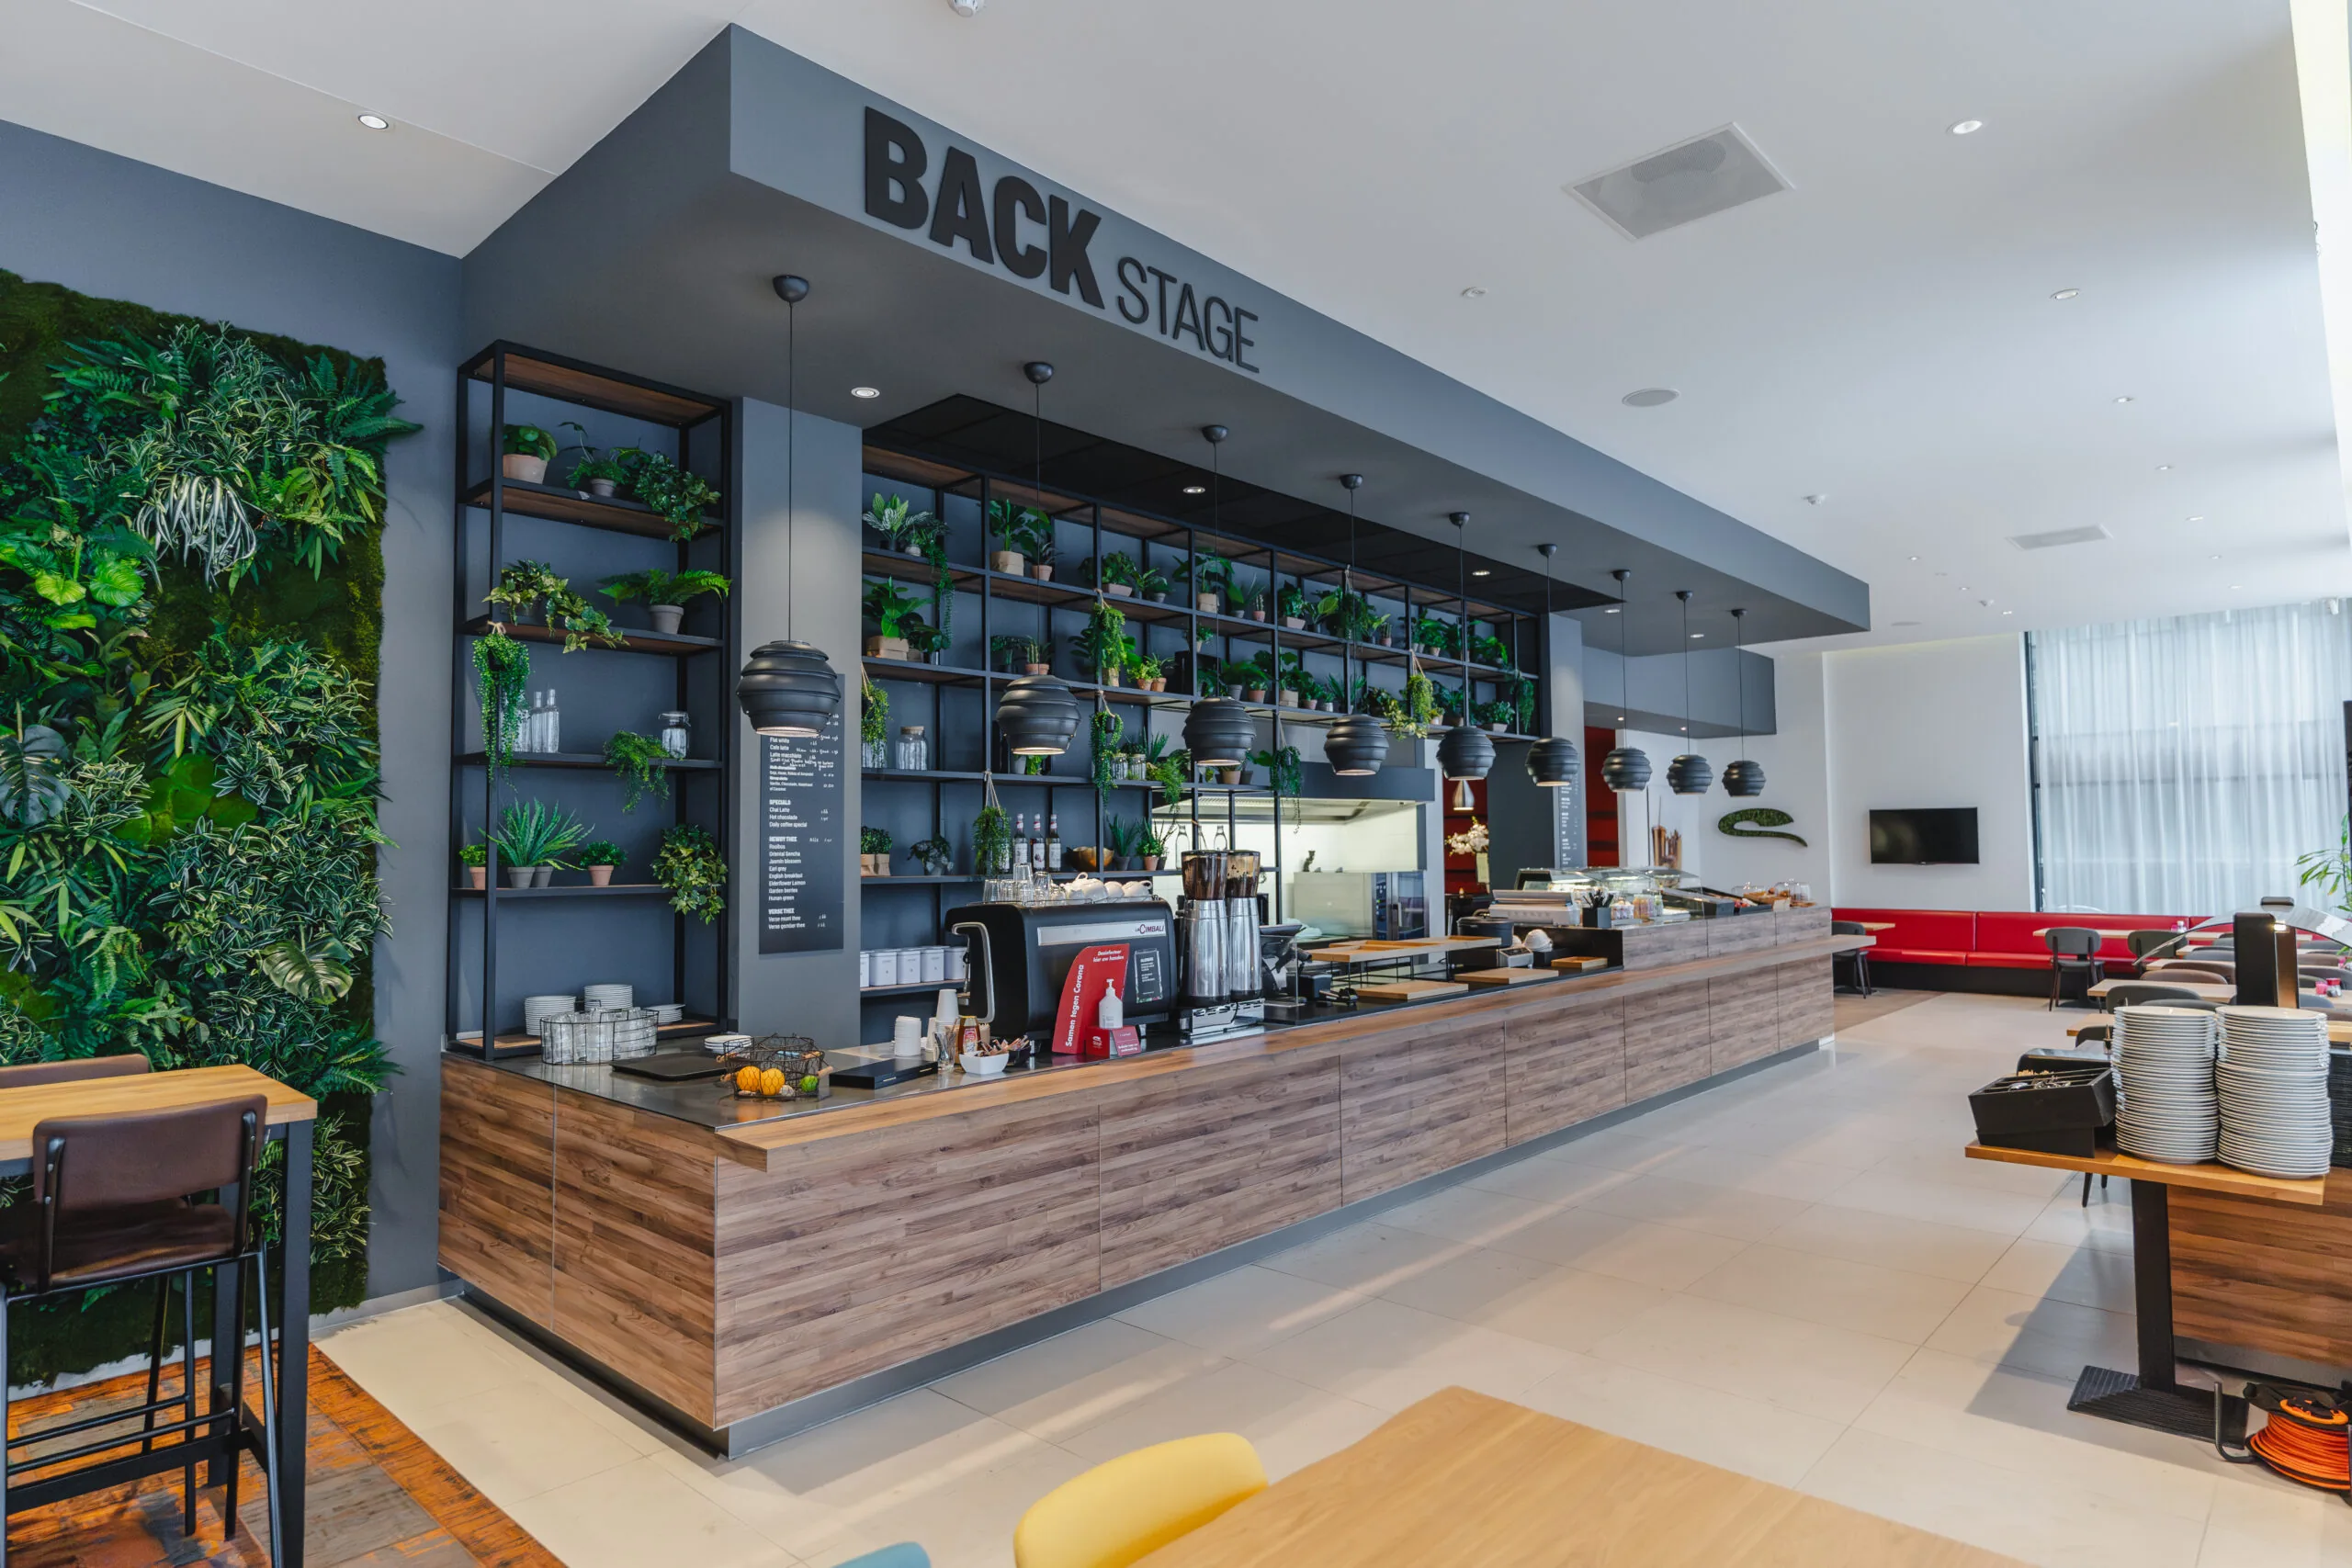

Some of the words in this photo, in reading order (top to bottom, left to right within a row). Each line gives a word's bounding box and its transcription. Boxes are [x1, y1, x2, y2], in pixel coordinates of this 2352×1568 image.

[865, 106, 1105, 310] BACK
[1117, 257, 1260, 373] STAGE
[1139, 923, 1165, 934] CIMBALI
[1073, 964, 1084, 993] Corona
[1070, 995, 1080, 1018] tegen
[1065, 1020, 1076, 1046] Samen
